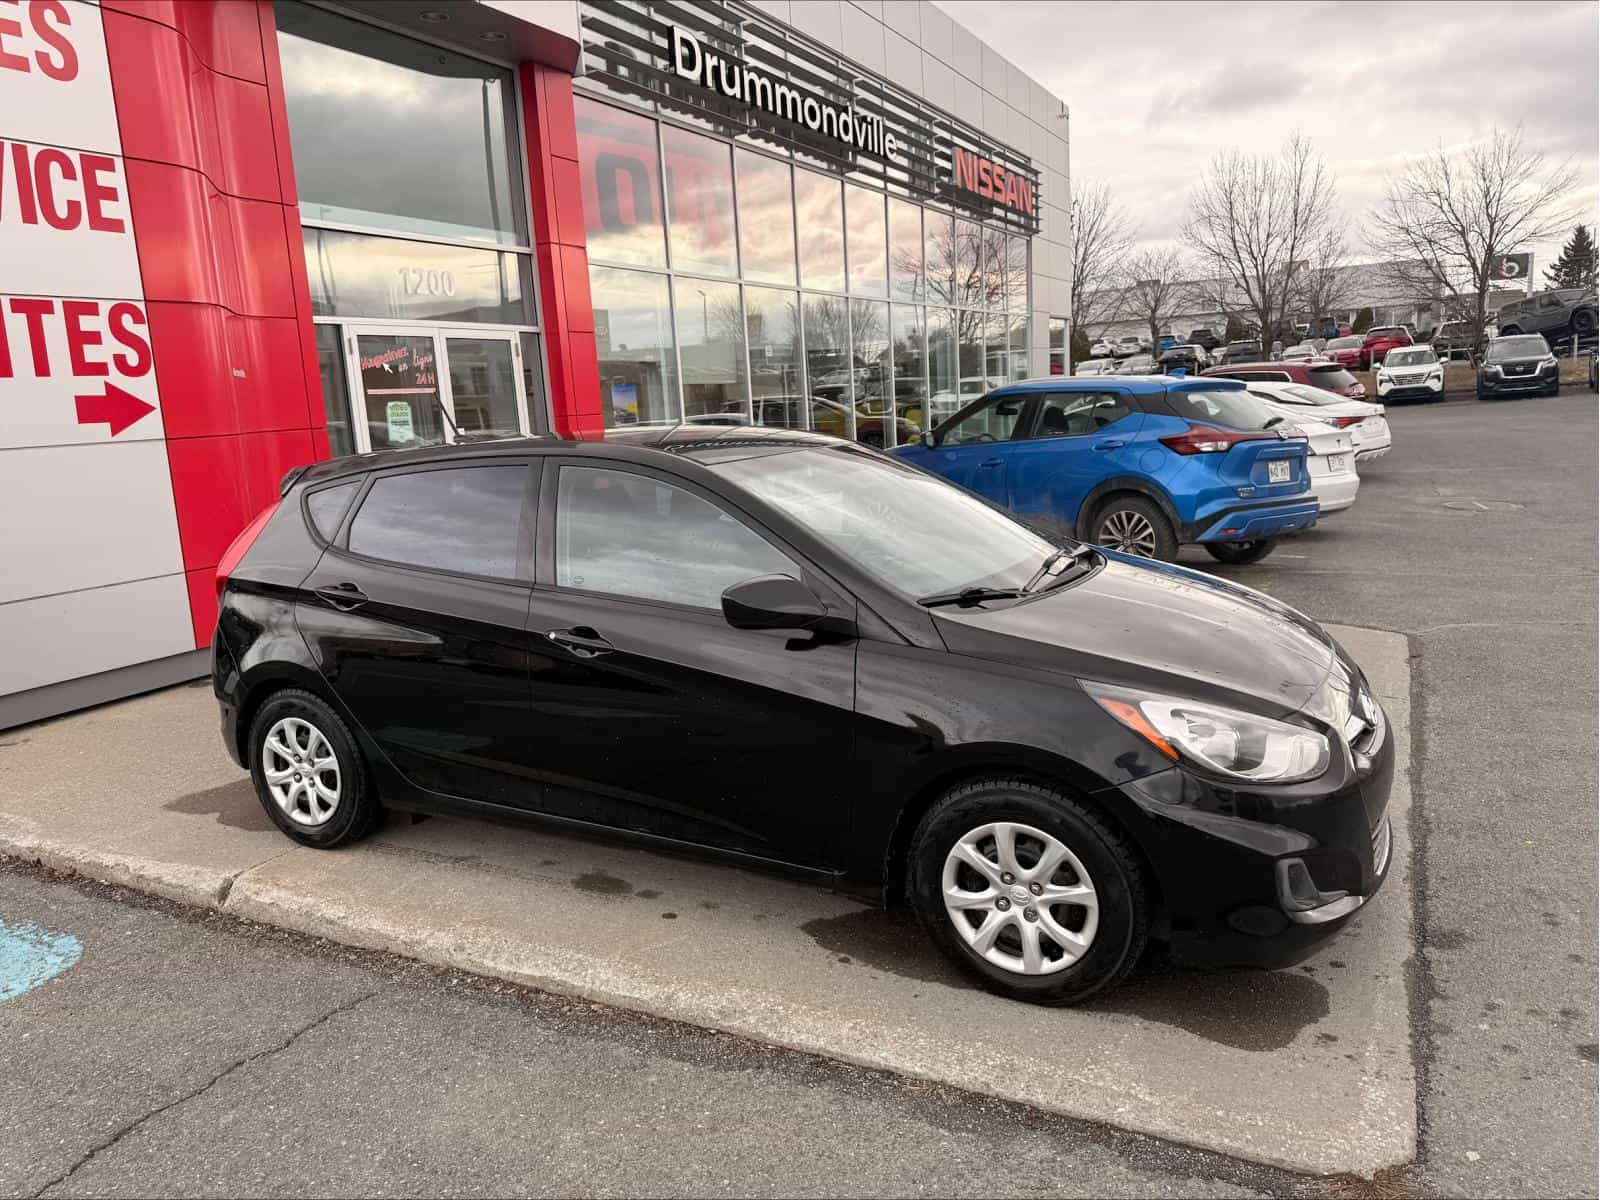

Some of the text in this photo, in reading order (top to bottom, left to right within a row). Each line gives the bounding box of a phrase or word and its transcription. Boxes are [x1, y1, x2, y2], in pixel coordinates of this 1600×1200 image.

[670, 24, 898, 160] Drummondville
[0, 141, 126, 234] ICE
[951, 146, 1034, 216] NISSAN
[398, 266, 456, 297] 1200
